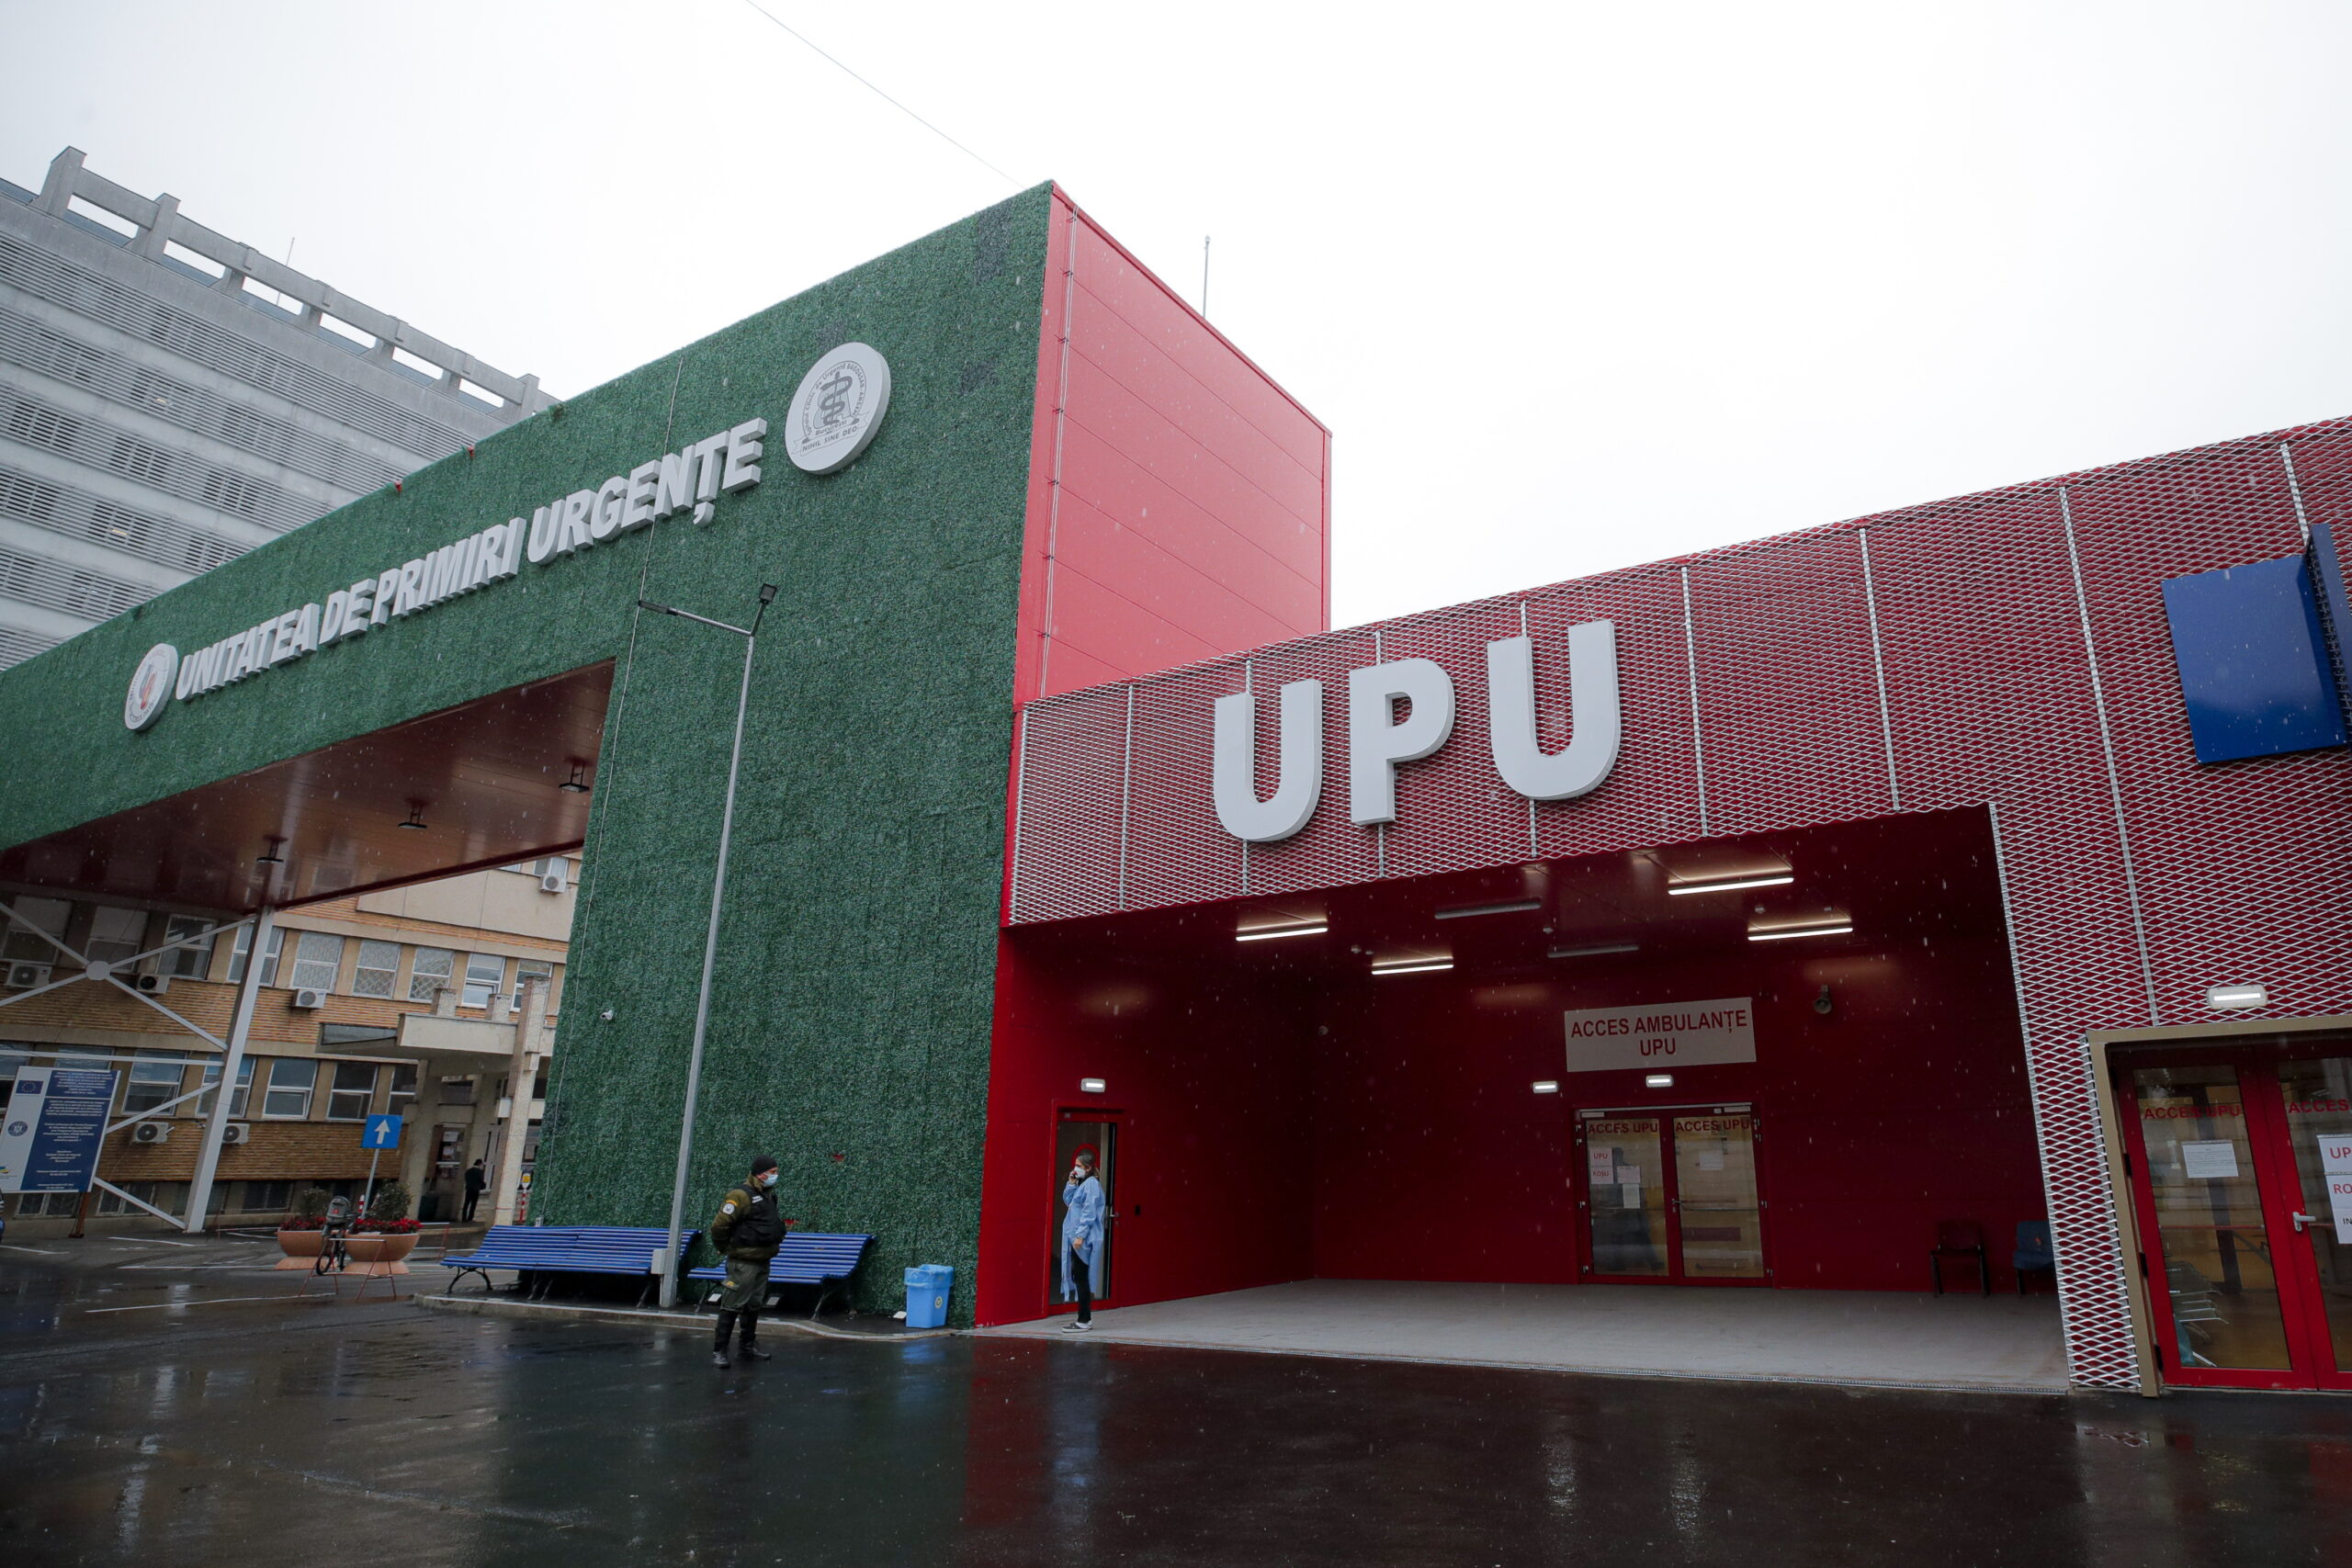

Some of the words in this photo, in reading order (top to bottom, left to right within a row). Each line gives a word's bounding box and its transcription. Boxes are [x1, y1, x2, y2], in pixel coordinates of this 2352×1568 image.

[802, 440, 821, 452] NIHIL
[824, 433, 841, 444] SINE
[842, 425, 858, 436] DEO
[175, 603, 321, 700] UNITATEA
[319, 577, 377, 645] DE
[370, 517, 526, 626] PRIMIRI
[527, 417, 767, 566] URGENȚE
[1213, 619, 1622, 842] UPU
[1571, 1018, 1630, 1038] ACCES
[1634, 1010, 1747, 1033] AMBULANȚE
[1640, 1038, 1677, 1056] UPU
[2144, 1105, 2201, 1120] ACCES
[2206, 1104, 2243, 1118] UPU
[2289, 1099, 2349, 1113] ACCES
[1588, 1122, 1629, 1134] ACCES
[1633, 1122, 1658, 1134] UPU
[1675, 1120, 1721, 1132] ACCES
[1724, 1118, 1750, 1130] UPU
